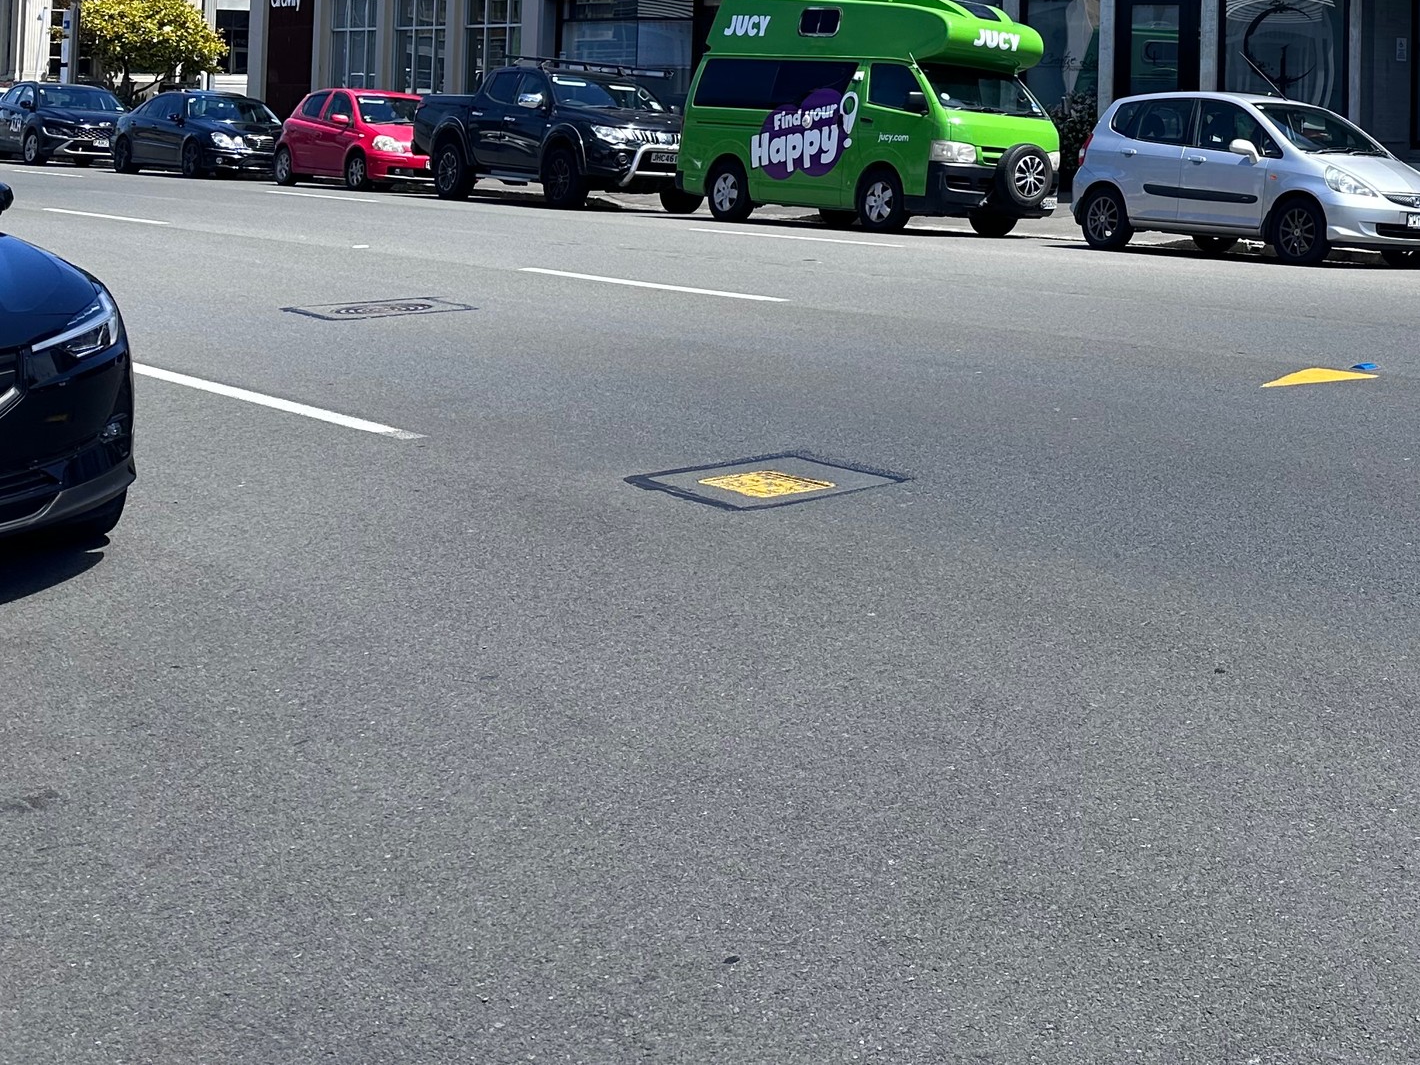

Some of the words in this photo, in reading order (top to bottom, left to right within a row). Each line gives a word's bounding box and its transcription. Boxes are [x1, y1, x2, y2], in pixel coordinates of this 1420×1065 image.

[724, 15, 770, 36] JUCY
[974, 28, 1020, 51] JUCY
[774, 110, 802, 130] Find
[803, 104, 838, 128] your
[878, 132, 909, 142] jucy.com
